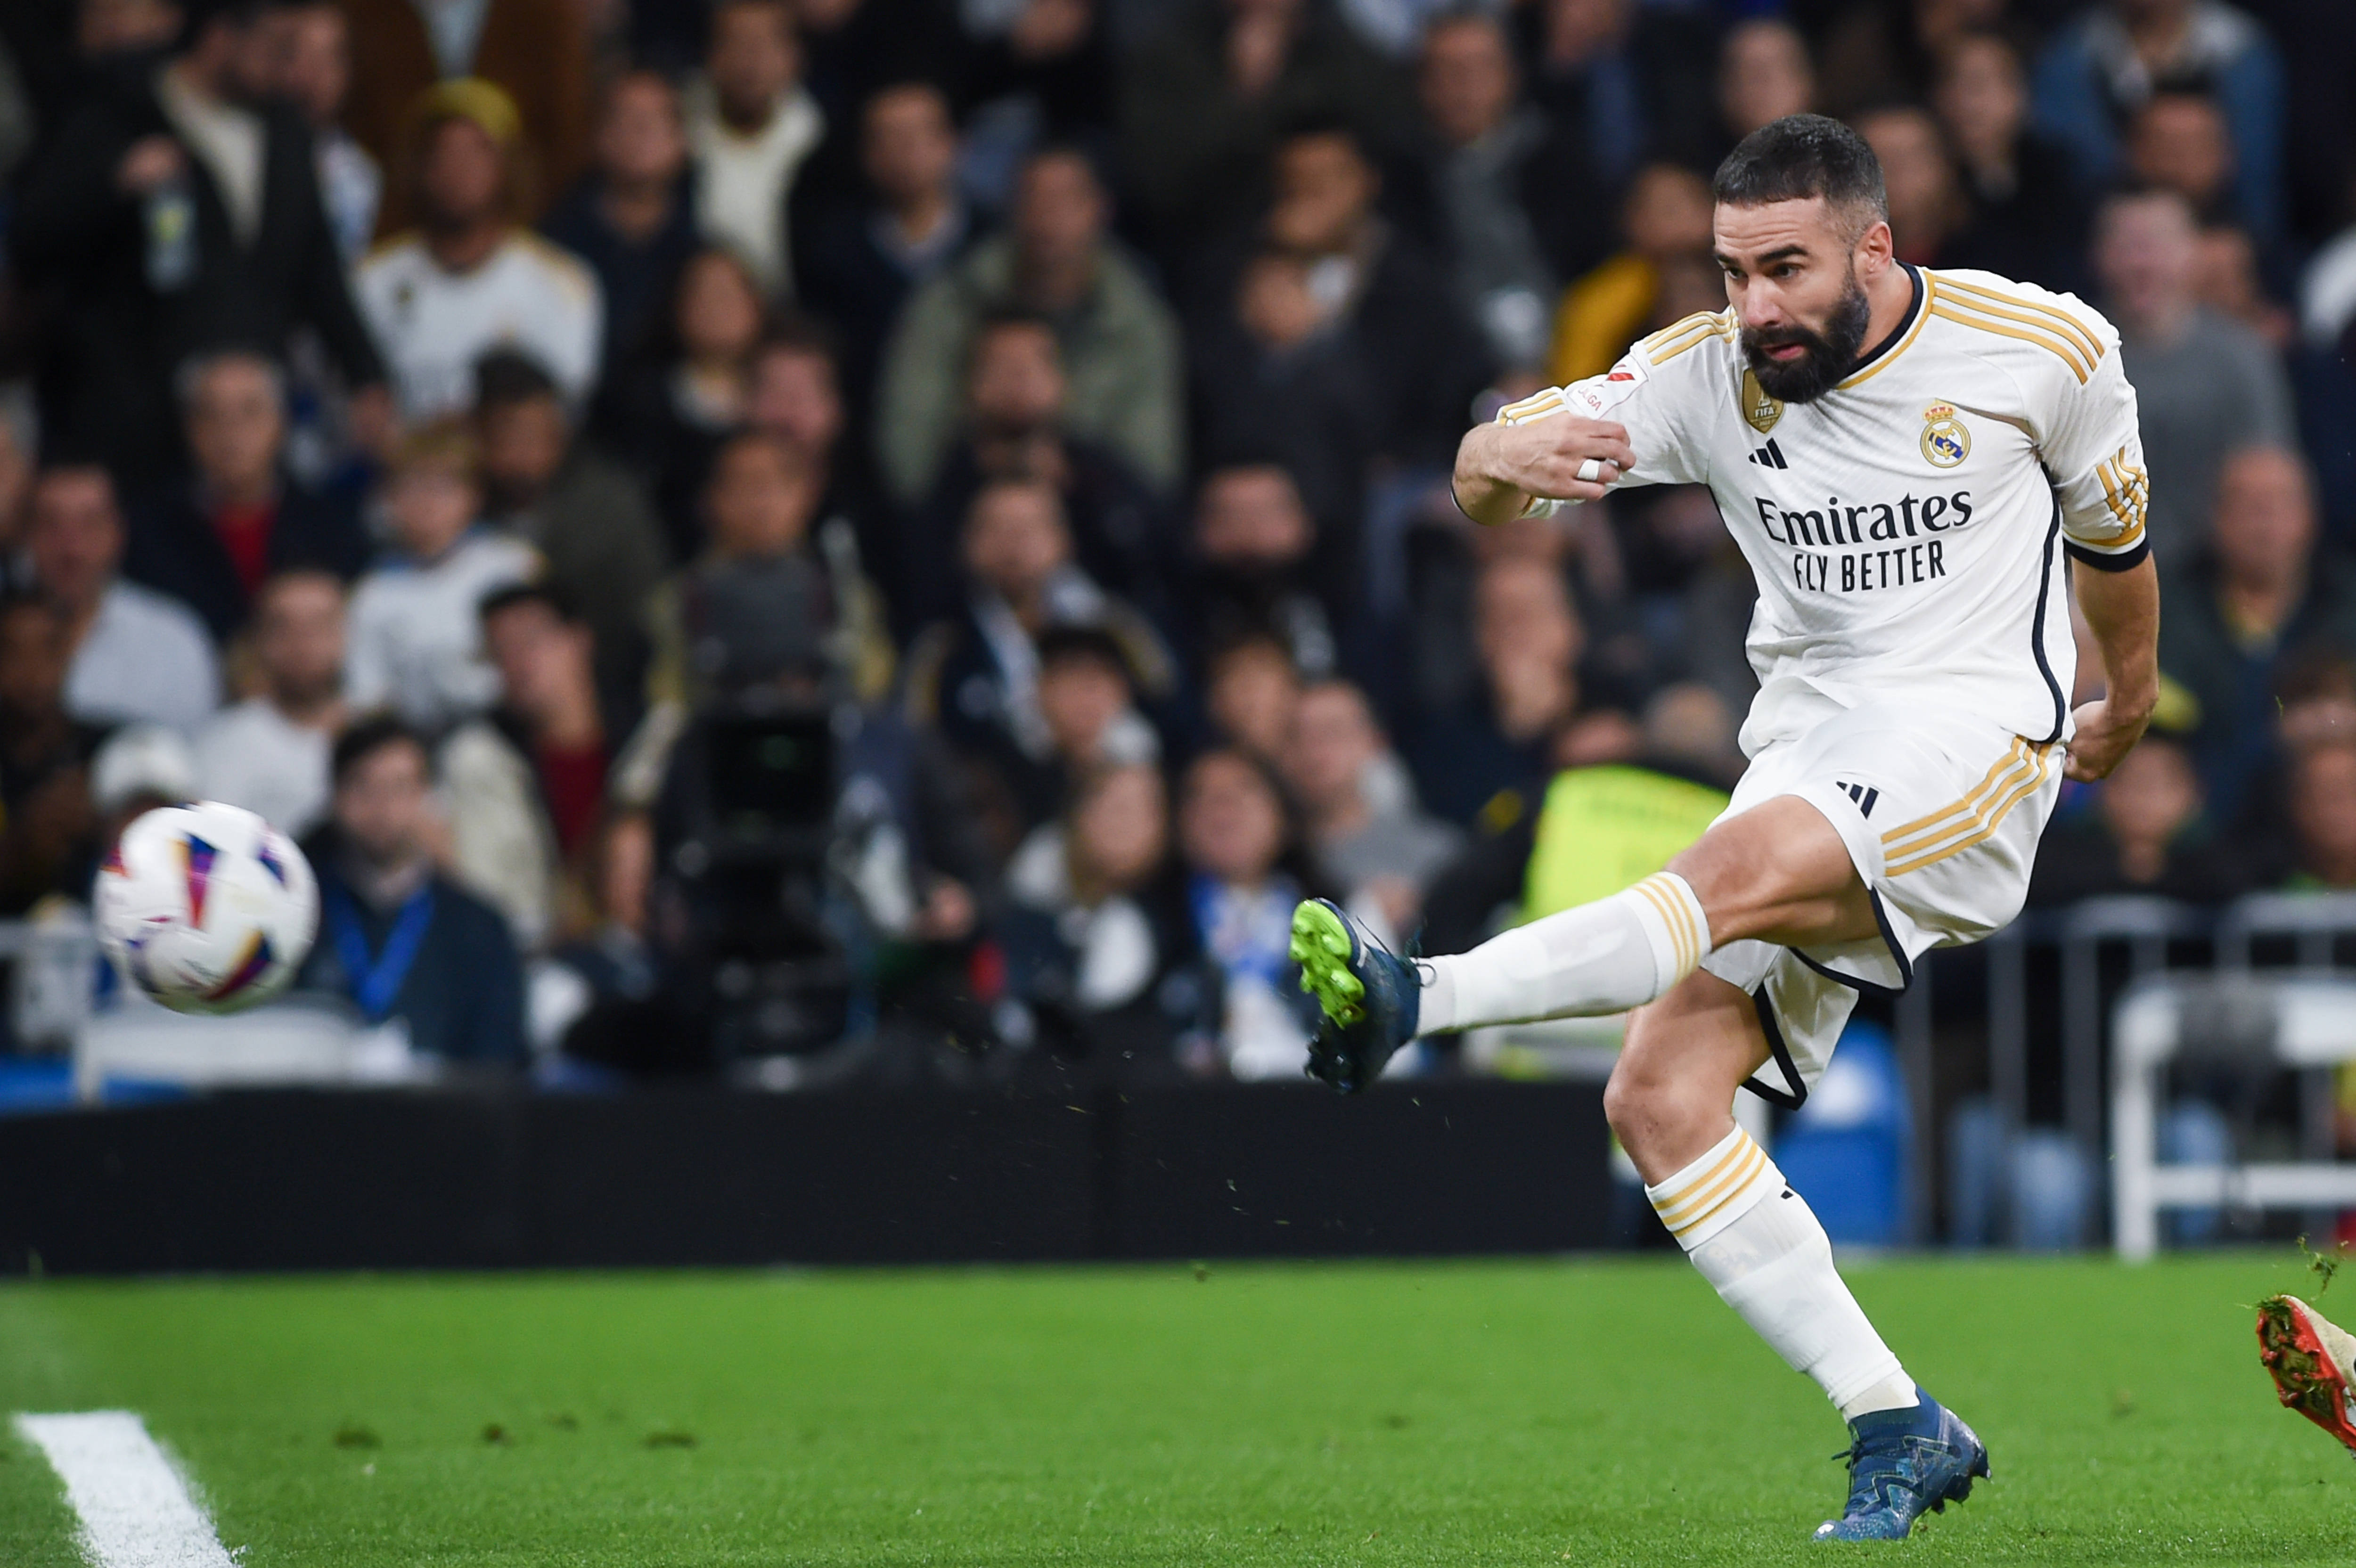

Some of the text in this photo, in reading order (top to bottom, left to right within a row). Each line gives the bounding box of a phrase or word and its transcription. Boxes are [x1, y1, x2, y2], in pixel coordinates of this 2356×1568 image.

[1755, 406, 1775, 418] FIFA
[1755, 491, 1972, 546] Emirates
[1793, 540, 1946, 592] FLY BETTER
